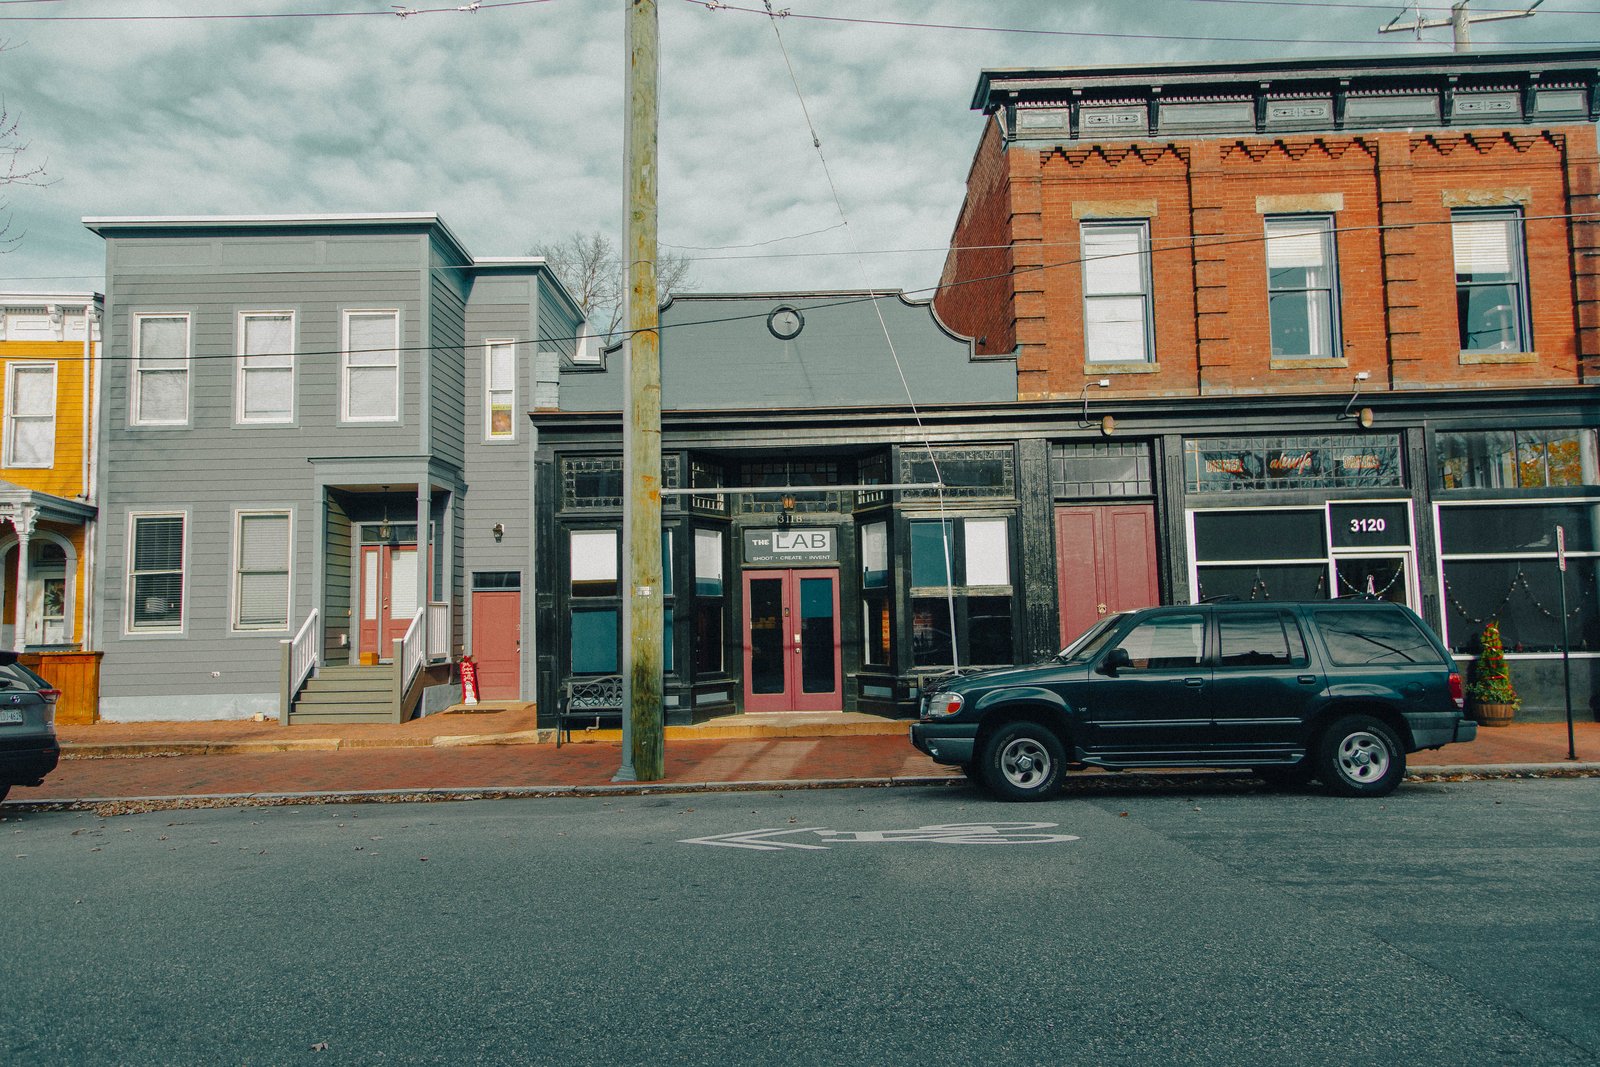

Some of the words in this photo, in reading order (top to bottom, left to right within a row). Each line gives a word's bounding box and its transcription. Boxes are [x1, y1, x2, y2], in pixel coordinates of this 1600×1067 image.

[778, 515, 802, 523] 3118
[1350, 518, 1385, 532] 3120
[776, 534, 826, 548] LAB
